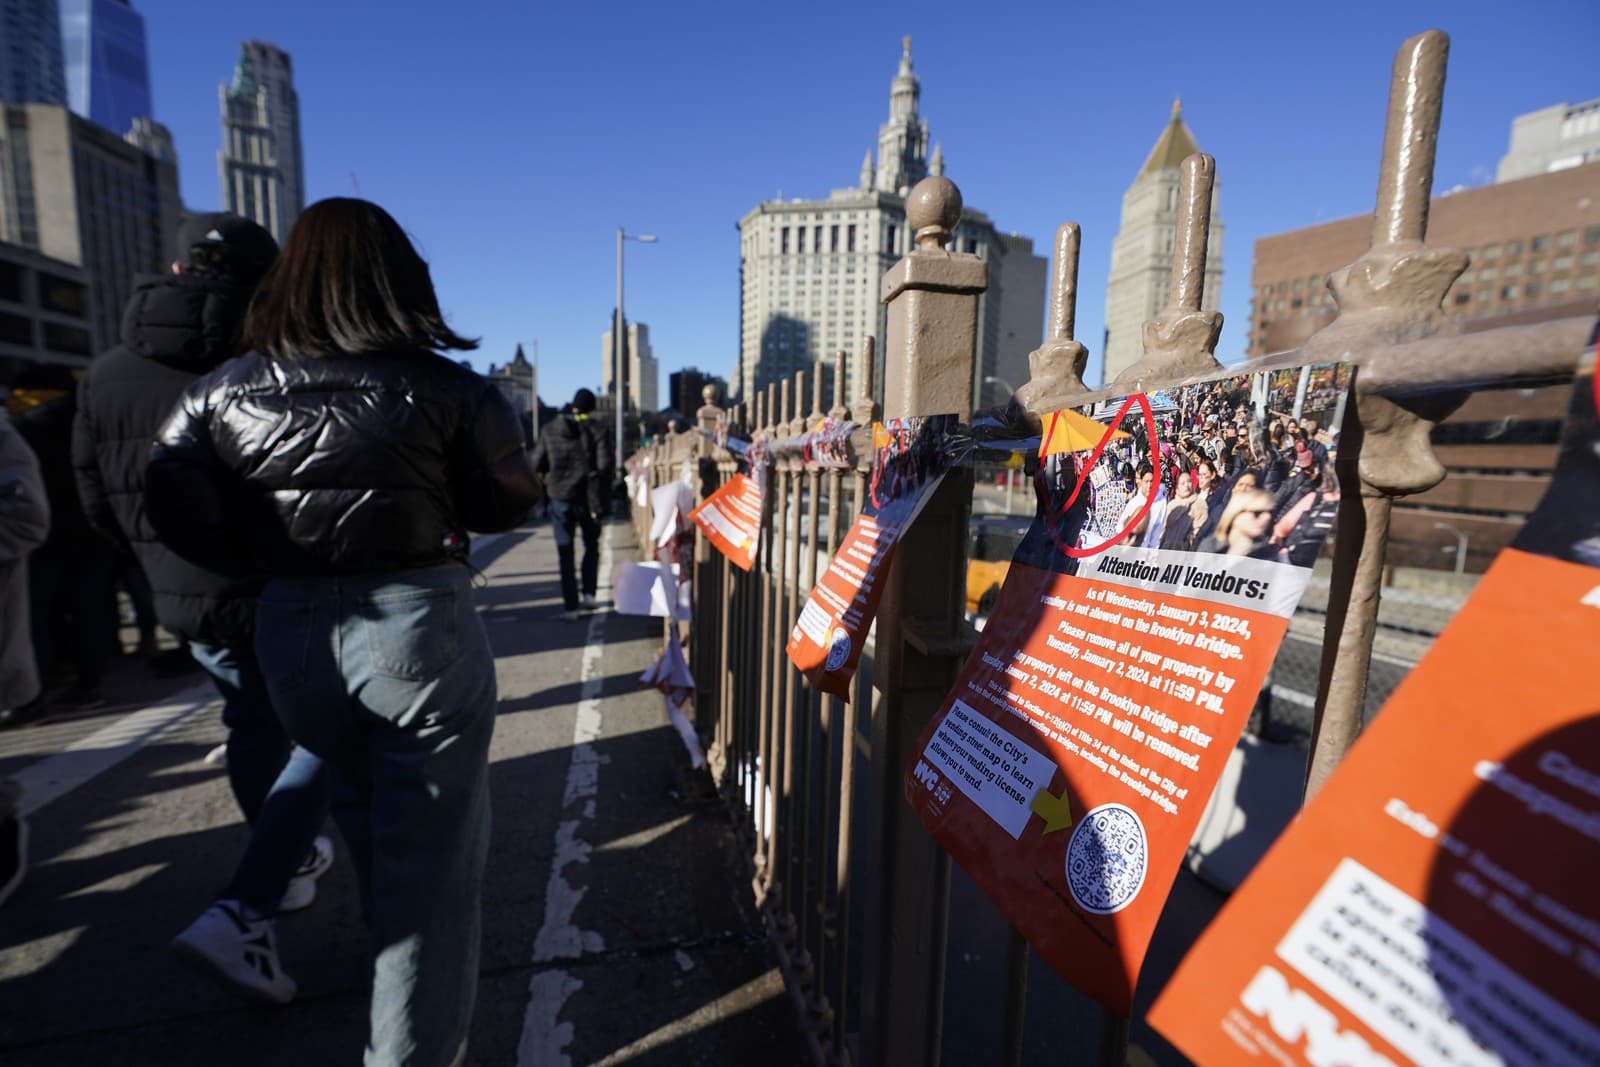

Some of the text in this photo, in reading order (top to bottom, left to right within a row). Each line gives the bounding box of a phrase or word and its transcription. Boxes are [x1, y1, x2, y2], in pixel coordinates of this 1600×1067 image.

[1086, 587, 1252, 640] As of Wednesday, January 3, 2024,
[1097, 556, 1269, 600] Attention All Vendors:
[1058, 620, 1236, 693] Please remove all of your property by
[1066, 600, 1076, 612] is
[1075, 604, 1090, 616] not
[1089, 607, 1122, 624] allowed
[1122, 617, 1134, 628] on
[1134, 618, 1150, 633] the
[1150, 621, 1196, 646] Brooklyn
[1194, 633, 1244, 660] Bridge.
[1024, 652, 1056, 677] property
[1056, 668, 1073, 684] left
[1072, 677, 1084, 688] on
[1083, 680, 1100, 696] the
[1099, 687, 1142, 716] Brooklyn
[1140, 705, 1178, 734] Bridge
[1178, 725, 1212, 748] after
[1046, 634, 1224, 714] Tuesday, January 2, 2024 at 11:59 PM.
[945, 718, 1034, 790] vending street map to learn
[989, 732, 1003, 747] the
[1003, 741, 1029, 765] City's
[1024, 700, 1045, 718] Section
[1070, 728, 1080, 736] of
[1092, 738, 1103, 750] 34
[1100, 745, 1110, 755] of
[1108, 747, 1120, 761] the
[1120, 754, 1140, 773] Rules
[1140, 767, 1150, 778] of
[1148, 770, 1161, 785] the
[1160, 778, 1178, 795] City
[1176, 788, 1188, 800] of
[1028, 675, 1038, 689] 2,
[1038, 680, 1061, 698] 2024
[1060, 691, 1071, 704] at
[1071, 696, 1096, 716] 11:59
[1094, 707, 1113, 726] PM
[1112, 718, 1134, 736] will
[1131, 725, 1145, 742] be
[1144, 734, 1200, 772] removed.
[913, 759, 939, 791] NYC
[938, 730, 1026, 805] where your vending license
[945, 757, 958, 770] you
[957, 765, 965, 775] to
[964, 770, 982, 792] vend.
[1050, 731, 1058, 740] on
[1057, 734, 1080, 755] bridges,
[1080, 747, 1108, 773] including
[1108, 764, 1120, 778] the
[1120, 772, 1152, 798] Brooklyn
[1150, 790, 1178, 815] Bridge.
